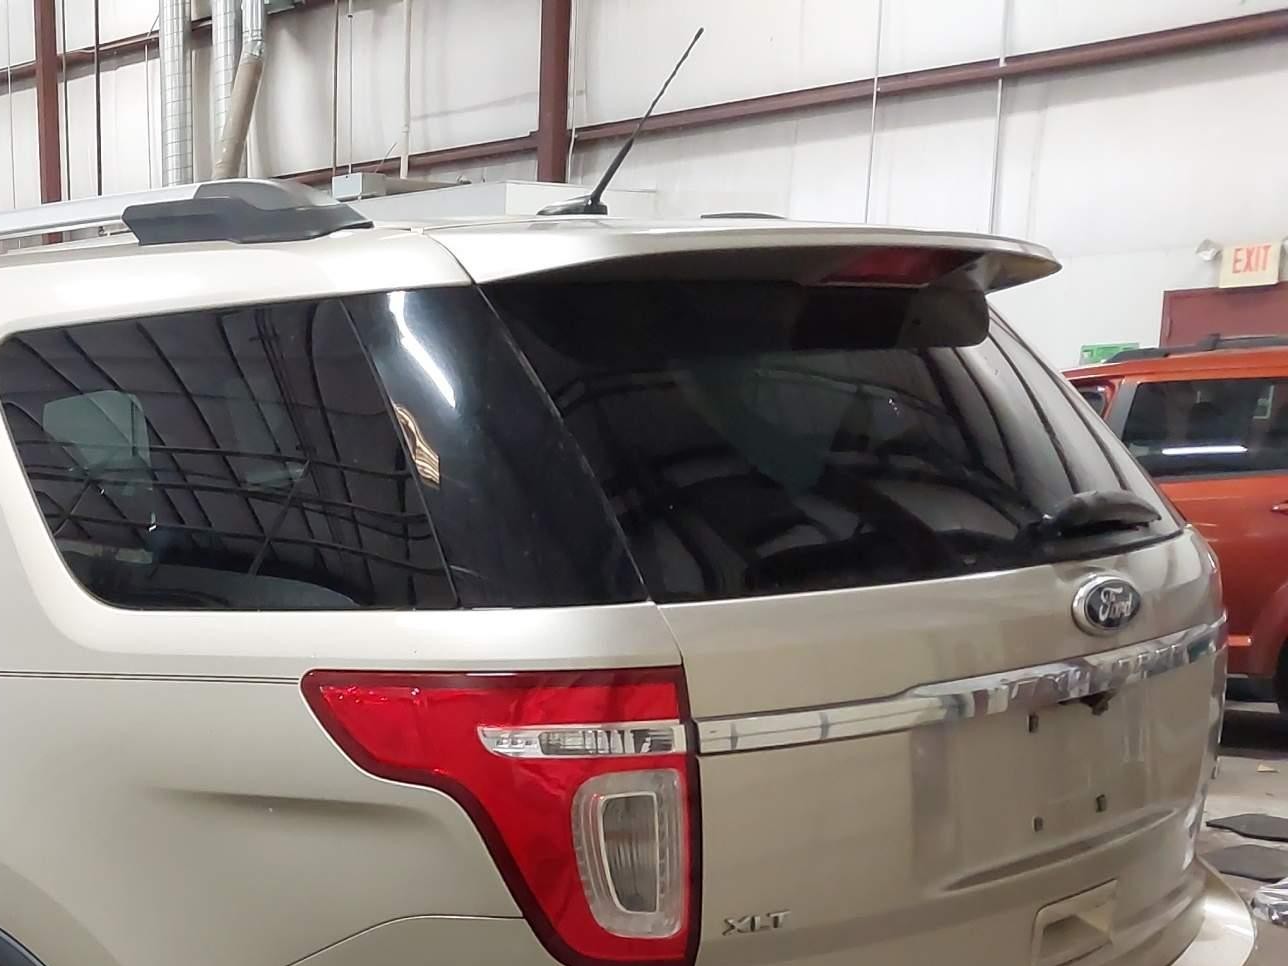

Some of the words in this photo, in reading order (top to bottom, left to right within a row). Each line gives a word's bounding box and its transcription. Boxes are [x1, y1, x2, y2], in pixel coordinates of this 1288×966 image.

[1232, 245, 1272, 274] EXIT
[1098, 586, 1133, 622] Ford
[722, 908, 792, 937] XLT
